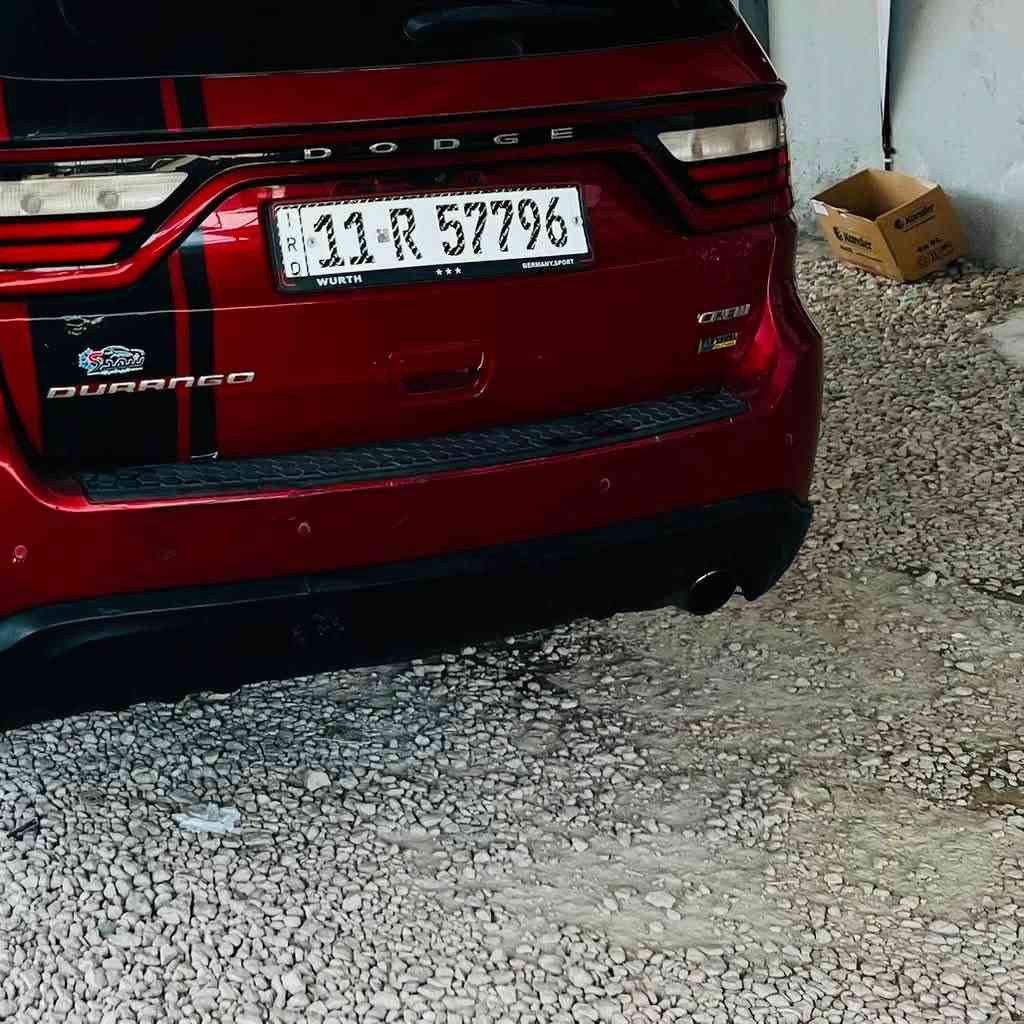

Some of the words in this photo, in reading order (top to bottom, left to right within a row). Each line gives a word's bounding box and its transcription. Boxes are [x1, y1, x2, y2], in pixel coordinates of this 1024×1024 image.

[303, 126, 574, 160] DODGE
[313, 211, 374, 268] 11
[389, 207, 422, 261] R
[436, 196, 568, 257] 57796
[316, 274, 363, 287] WURTH
[46, 371, 256, 399] DURANGO
